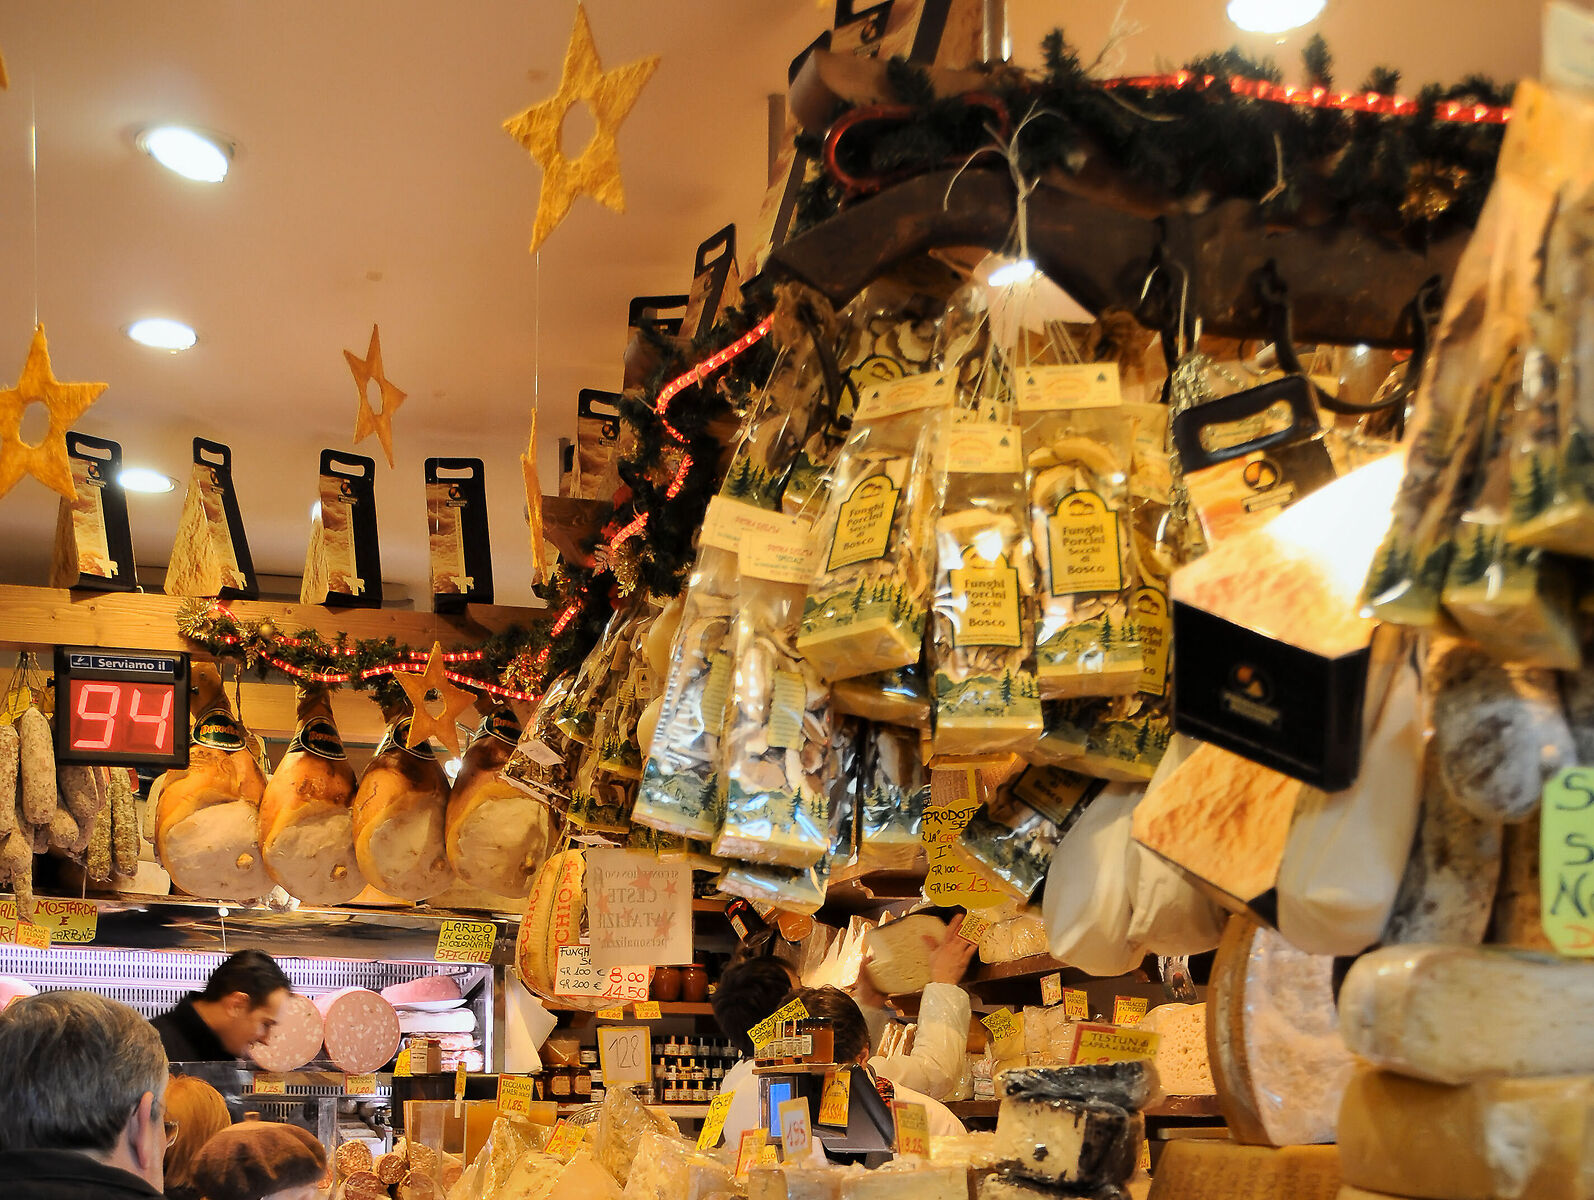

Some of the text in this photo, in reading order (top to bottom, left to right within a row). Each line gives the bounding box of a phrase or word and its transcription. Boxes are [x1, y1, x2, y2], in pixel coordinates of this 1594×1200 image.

[1063, 526, 1104, 538] Funghi
[843, 538, 874, 551] Bosco
[1063, 536, 1105, 547] Porcini
[1069, 547, 1101, 556] Secchi
[1067, 565, 1105, 575] Bosco
[964, 579, 1005, 592] Funghi
[965, 590, 1006, 601] Porcini
[969, 618, 1006, 628] Bosco
[98, 658, 166, 671] Serviamo il
[73, 684, 173, 749] 94
[34, 900, 97, 917] MOSTARDA
[59, 916, 70, 926] E
[443, 921, 493, 933] LARDO
[51, 928, 96, 941] CARPONE
[444, 932, 490, 942] IN CONCA
[449, 941, 493, 949] COLONNATA
[436, 948, 491, 963] SPECIALE
[560, 946, 590, 957] FUNGH
[574, 968, 591, 976] 100
[572, 980, 590, 989] 200
[1091, 1033, 1137, 1047] TESTUN
[608, 1034, 641, 1069] 128
[502, 1079, 531, 1091] REGGIANO
